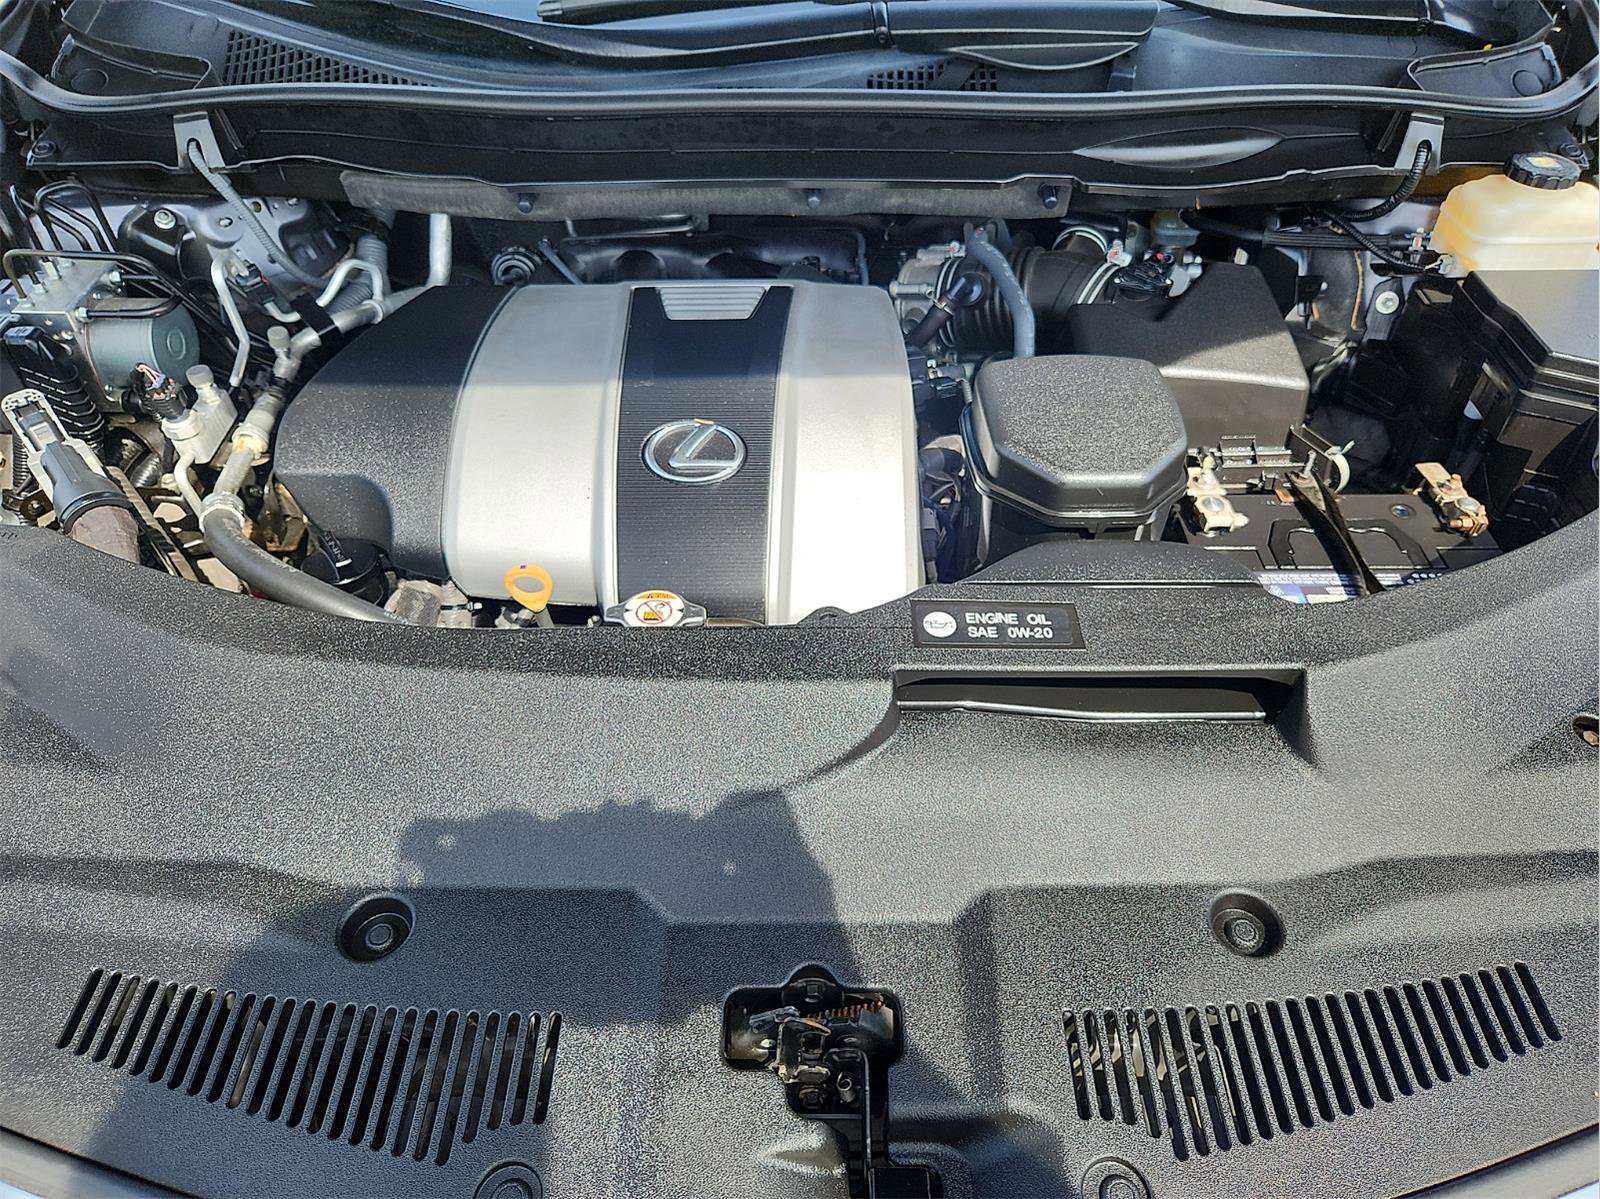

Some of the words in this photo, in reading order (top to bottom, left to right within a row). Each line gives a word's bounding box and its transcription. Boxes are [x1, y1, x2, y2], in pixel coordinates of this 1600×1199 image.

[965, 612, 1019, 625] ENGINE
[1026, 613, 1052, 625] OIL
[967, 626, 998, 638] SAE
[1007, 626, 1053, 639] 0W-20
